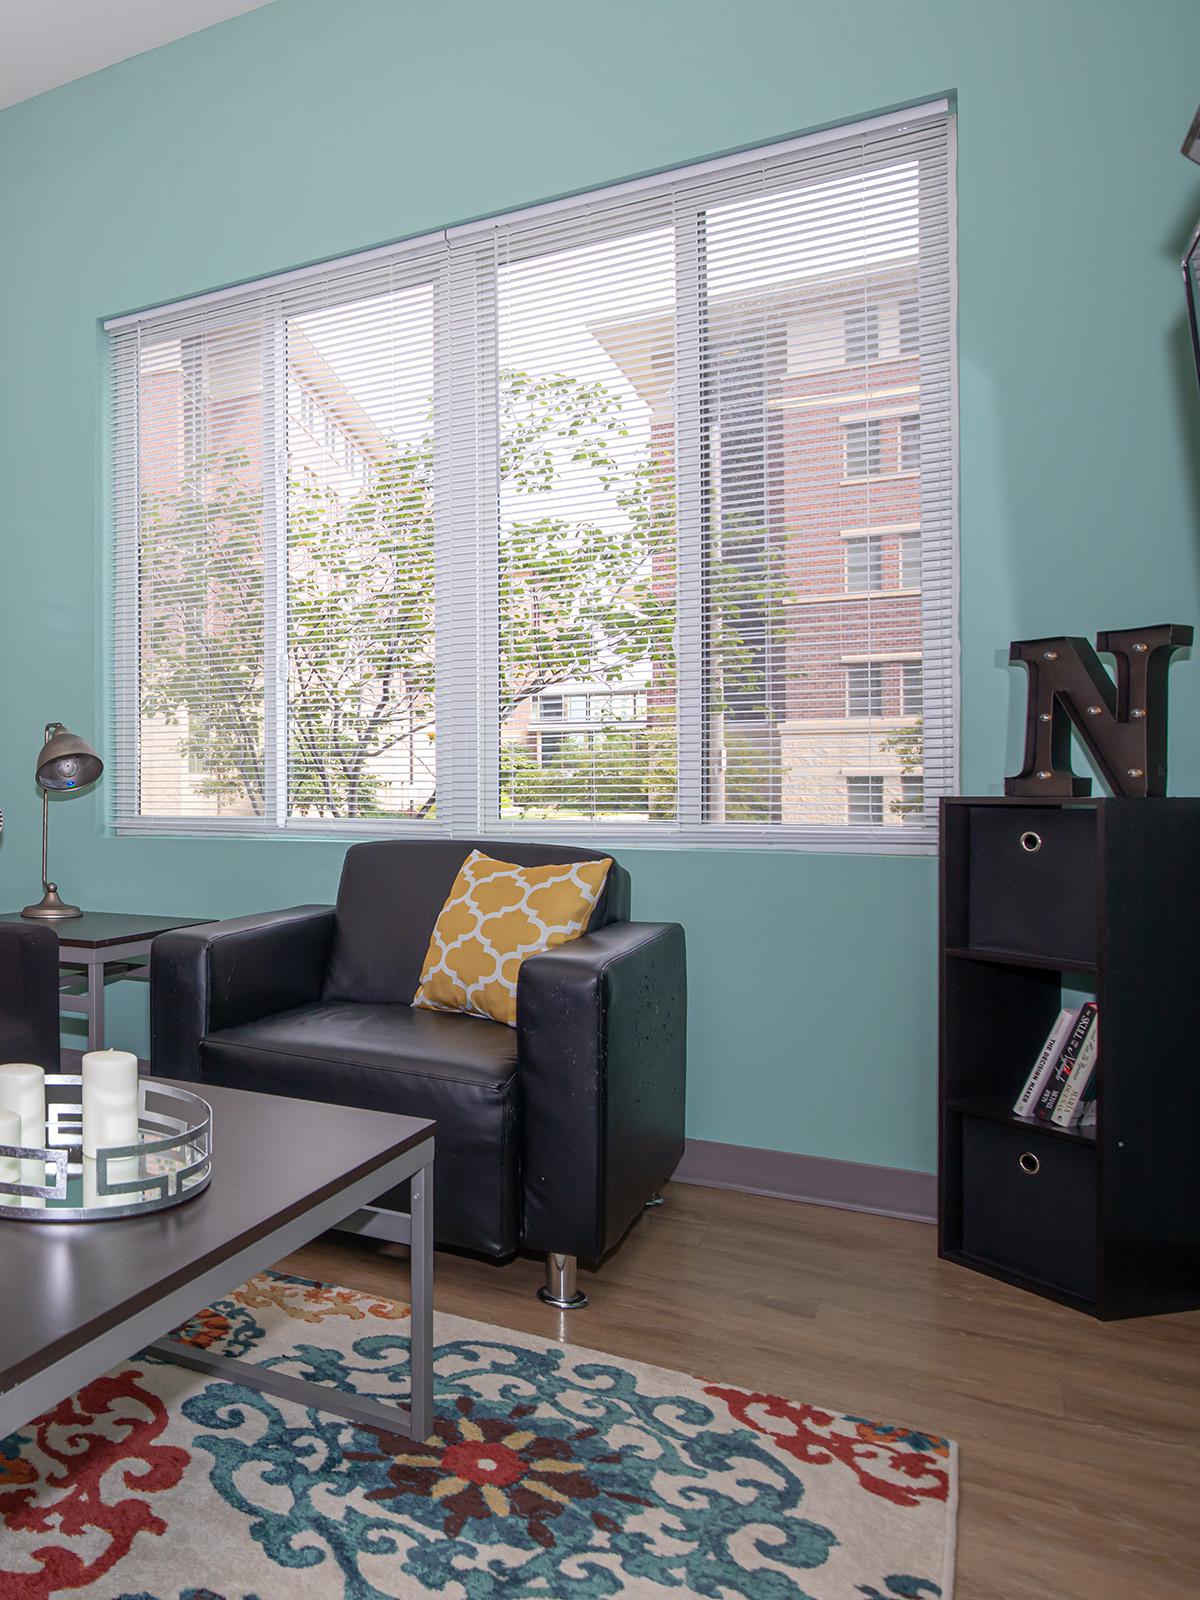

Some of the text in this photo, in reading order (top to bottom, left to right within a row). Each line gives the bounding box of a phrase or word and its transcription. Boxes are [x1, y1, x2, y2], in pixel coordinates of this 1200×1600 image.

[1004, 624, 1194, 797] N
[1073, 1016, 1091, 1041] SKULL
[1023, 1038, 1056, 1103] THE DECISION MAKER
